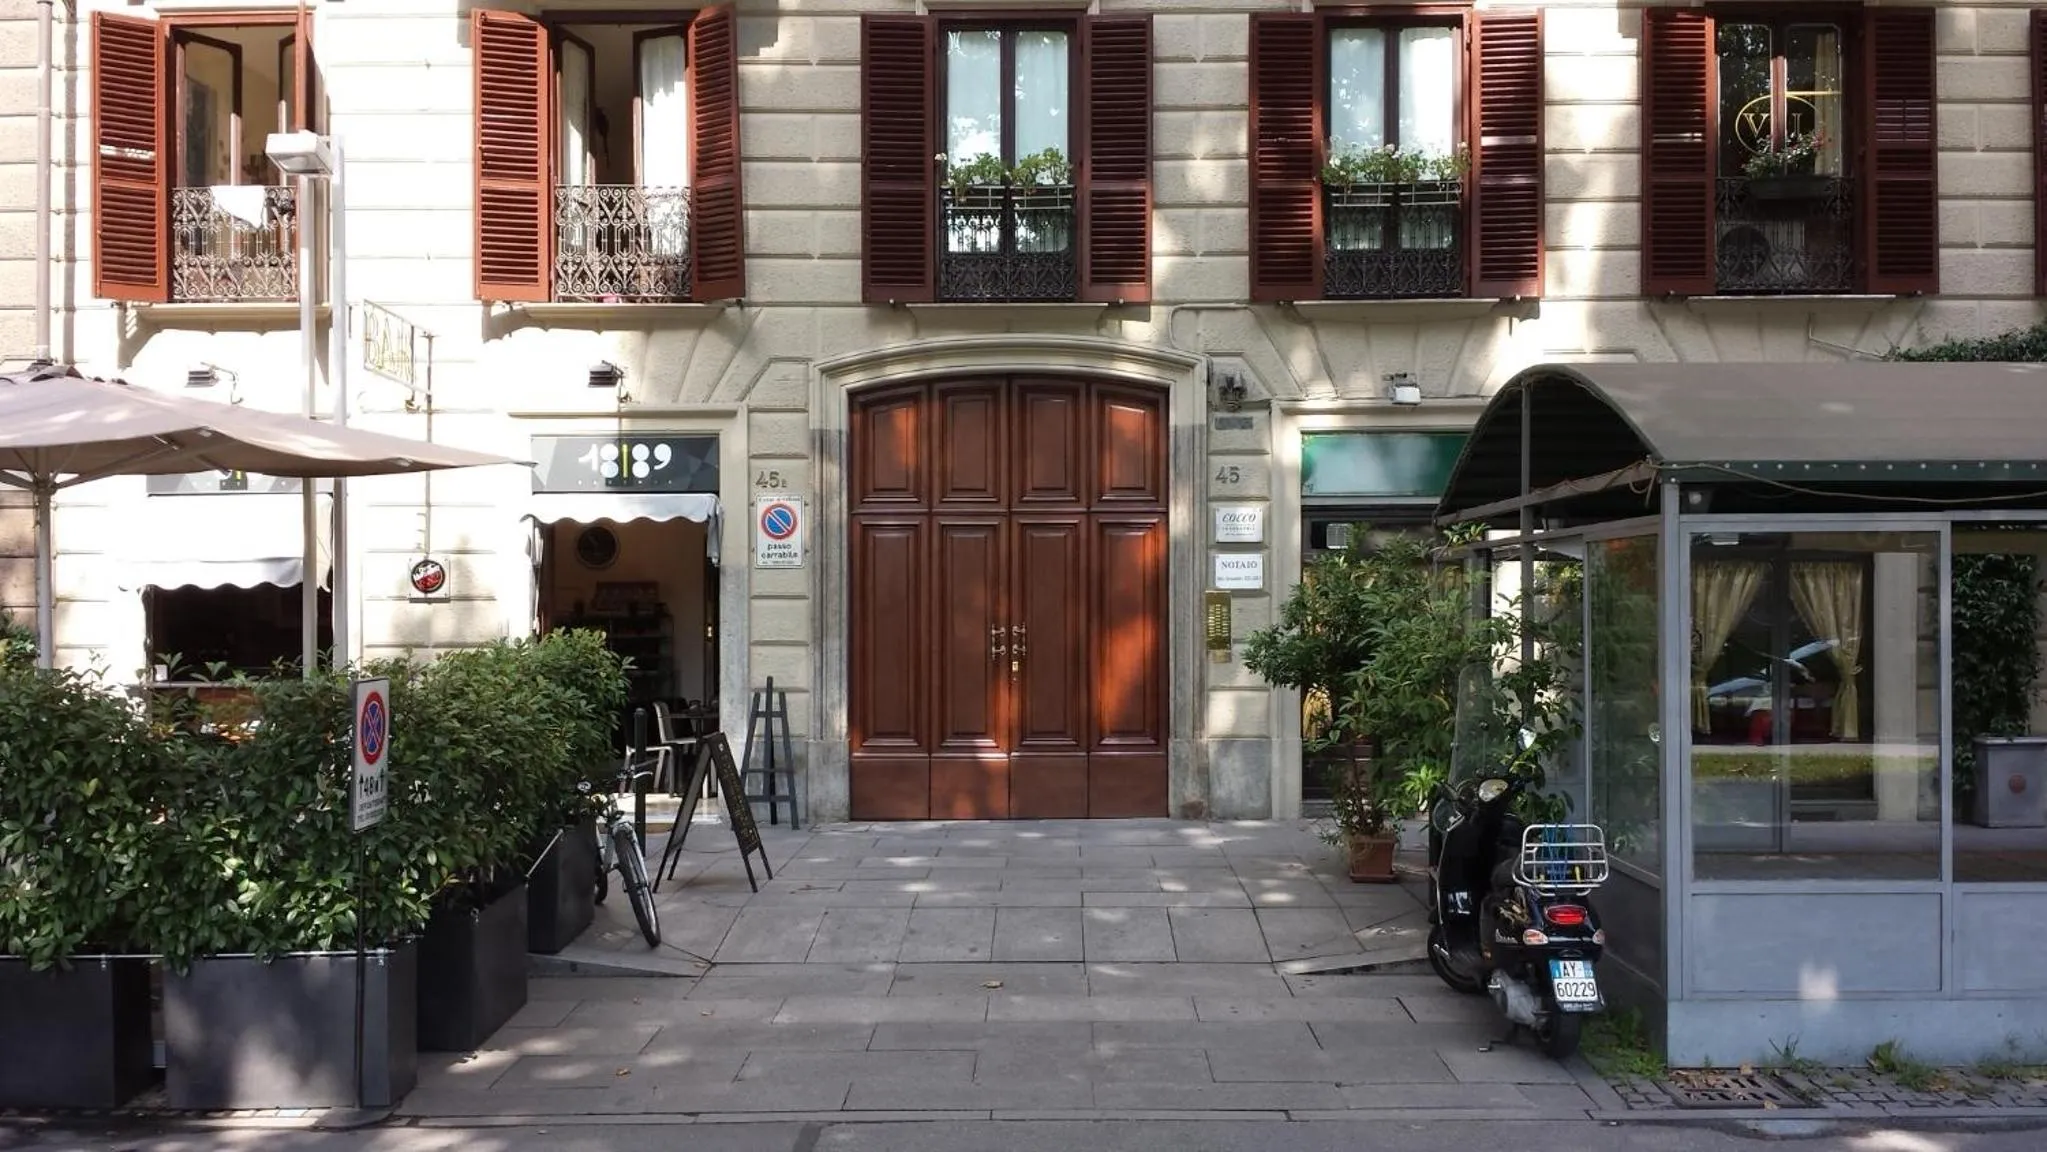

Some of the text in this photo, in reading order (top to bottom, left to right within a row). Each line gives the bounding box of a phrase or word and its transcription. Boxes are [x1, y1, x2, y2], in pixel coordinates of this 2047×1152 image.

[1216, 466, 1240, 484] 45
[767, 543, 792, 551] passo
[761, 551, 798, 559] carrabile
[1221, 561, 1257, 569] NOTAIO
[1563, 962, 1576, 977] AY
[1557, 982, 1596, 997] 60229
